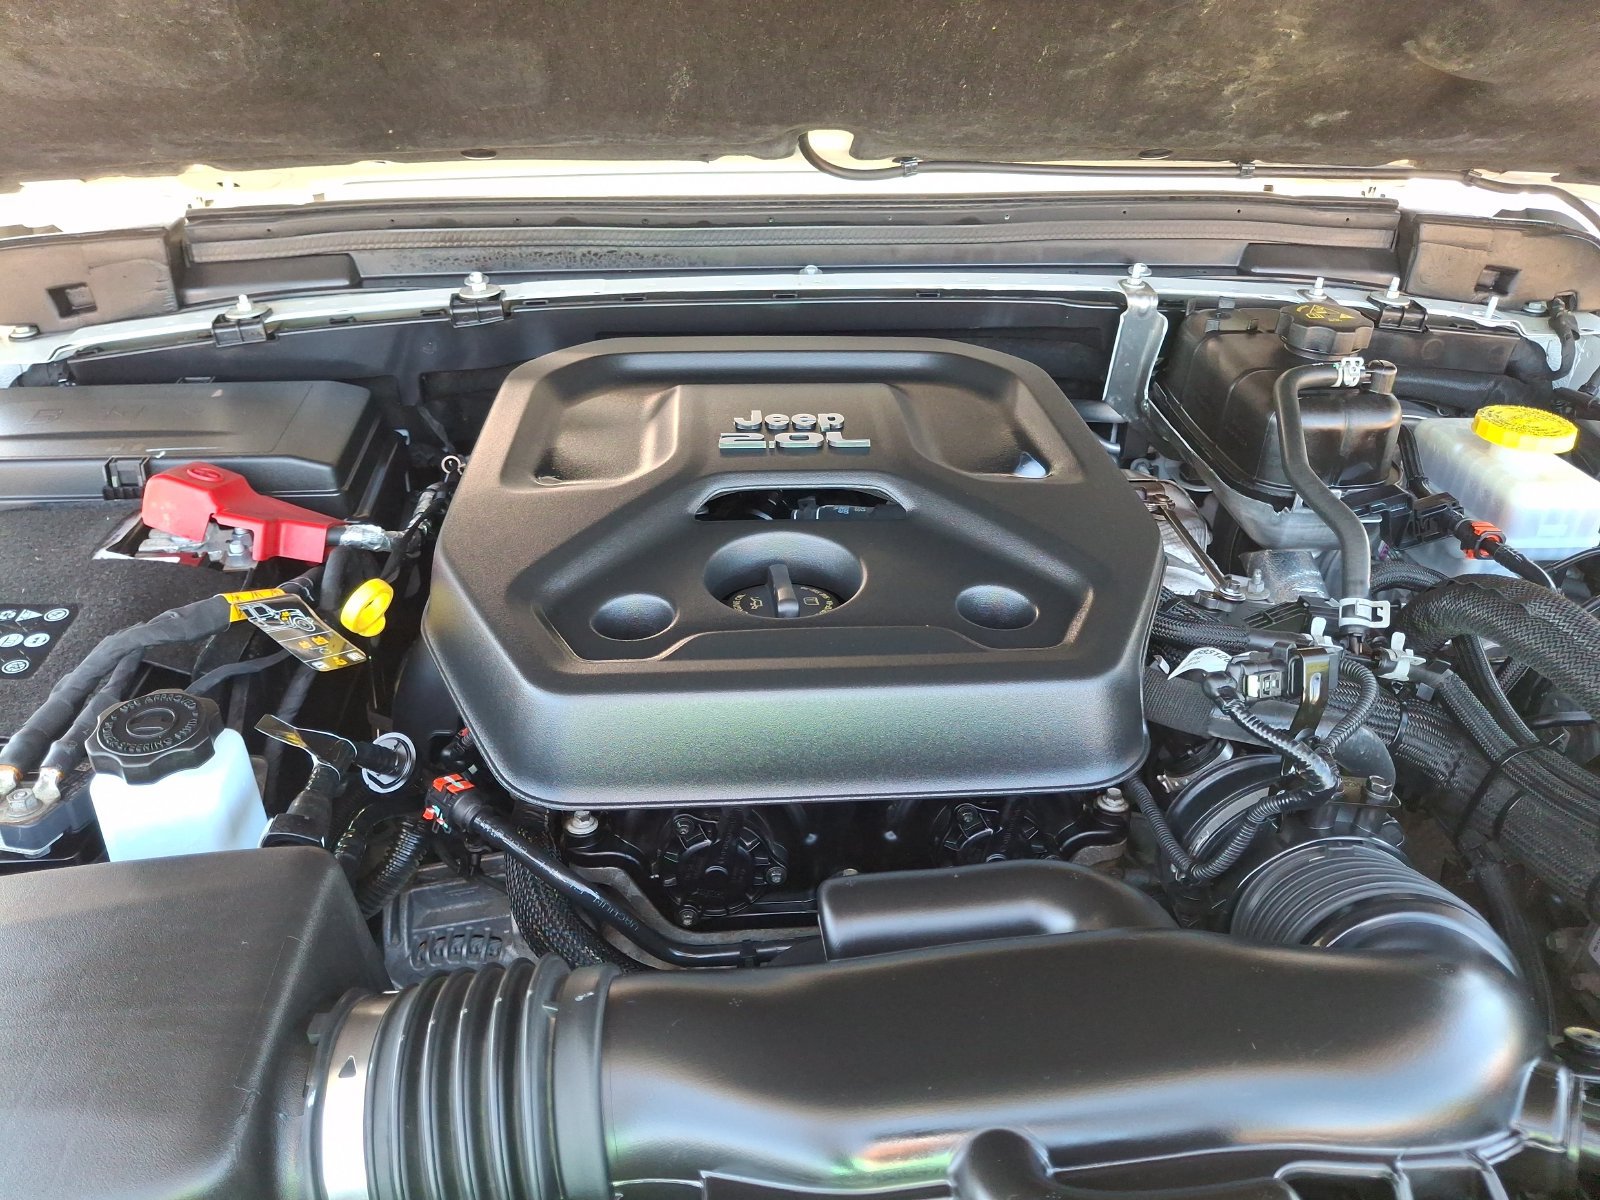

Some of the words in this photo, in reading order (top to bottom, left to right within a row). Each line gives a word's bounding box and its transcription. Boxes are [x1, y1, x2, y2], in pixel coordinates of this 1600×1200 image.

[734, 410, 844, 431] Jeep
[719, 432, 871, 449] 2.0L
[144, 693, 197, 709] APPROVED
[118, 737, 173, 753] STEERING
